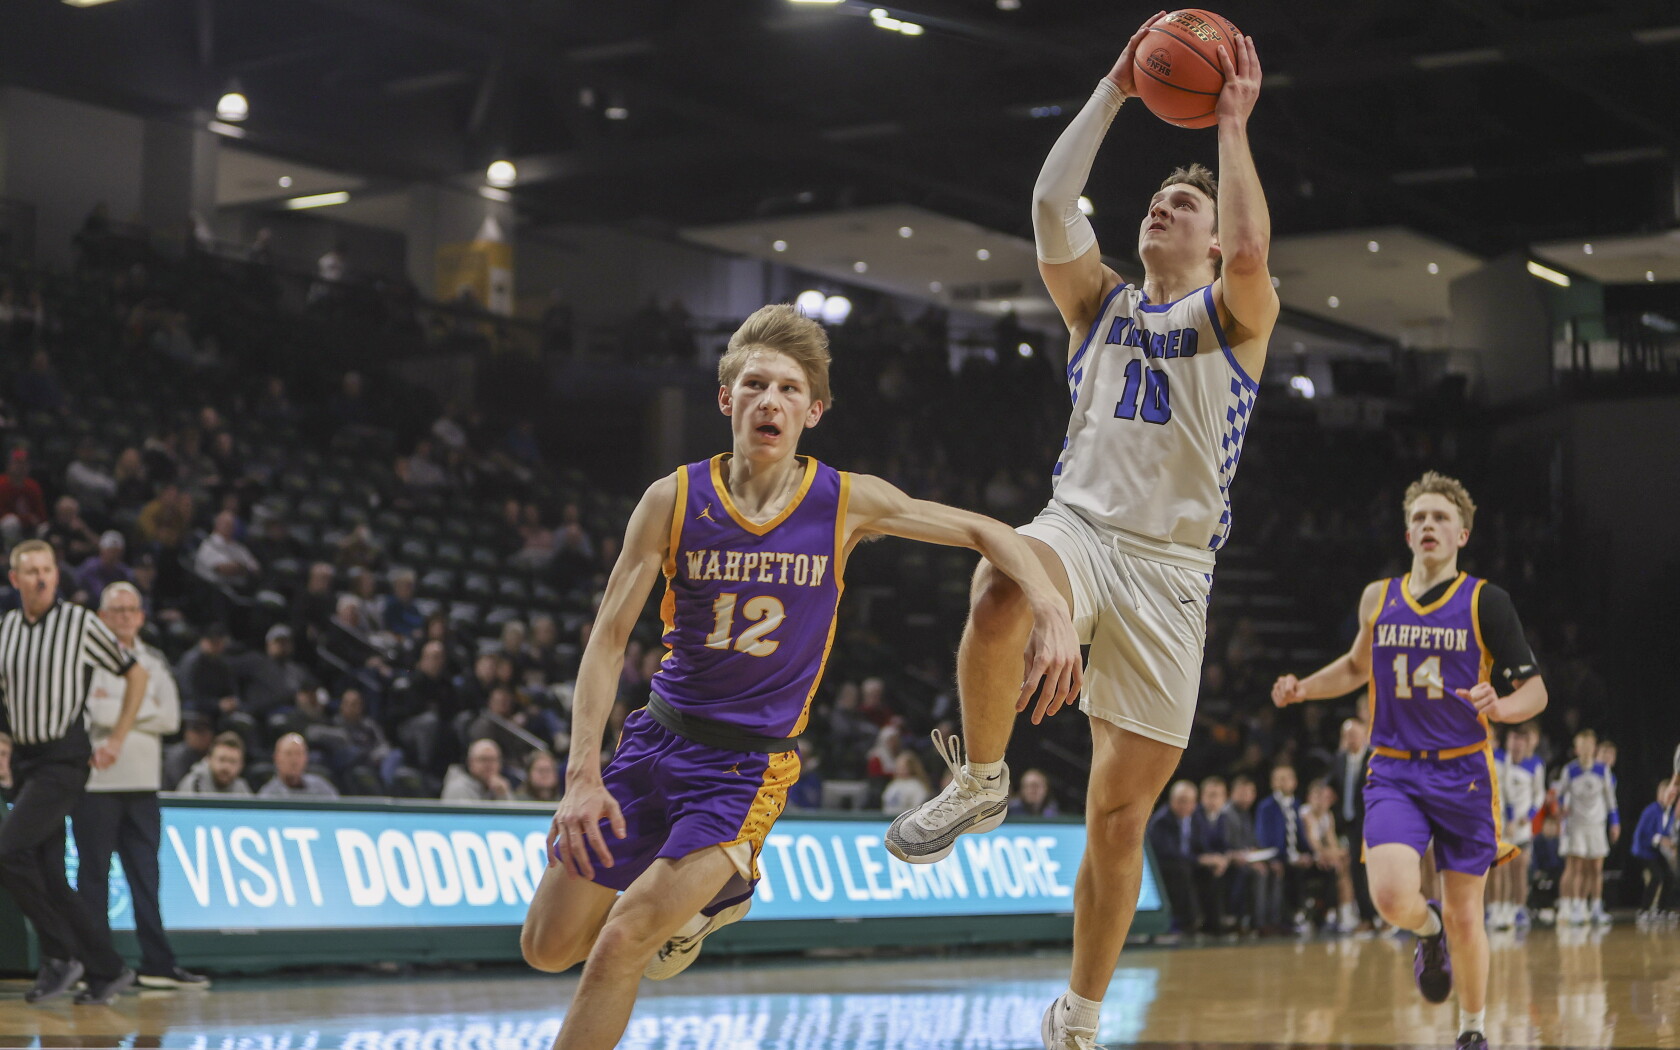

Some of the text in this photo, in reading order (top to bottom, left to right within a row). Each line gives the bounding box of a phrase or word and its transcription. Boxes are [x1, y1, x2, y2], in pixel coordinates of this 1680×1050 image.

[1174, 11, 1222, 41] EGACY
[1114, 359, 1171, 425] 10
[686, 550, 829, 587] WAHPETON
[704, 593, 787, 657] 12
[1377, 624, 1468, 651] WAHPETON
[1393, 654, 1444, 699] 14
[167, 826, 323, 907] VISIT
[766, 834, 834, 902] TO
[831, 835, 970, 900] LEARN
[963, 836, 1071, 899] MORE
